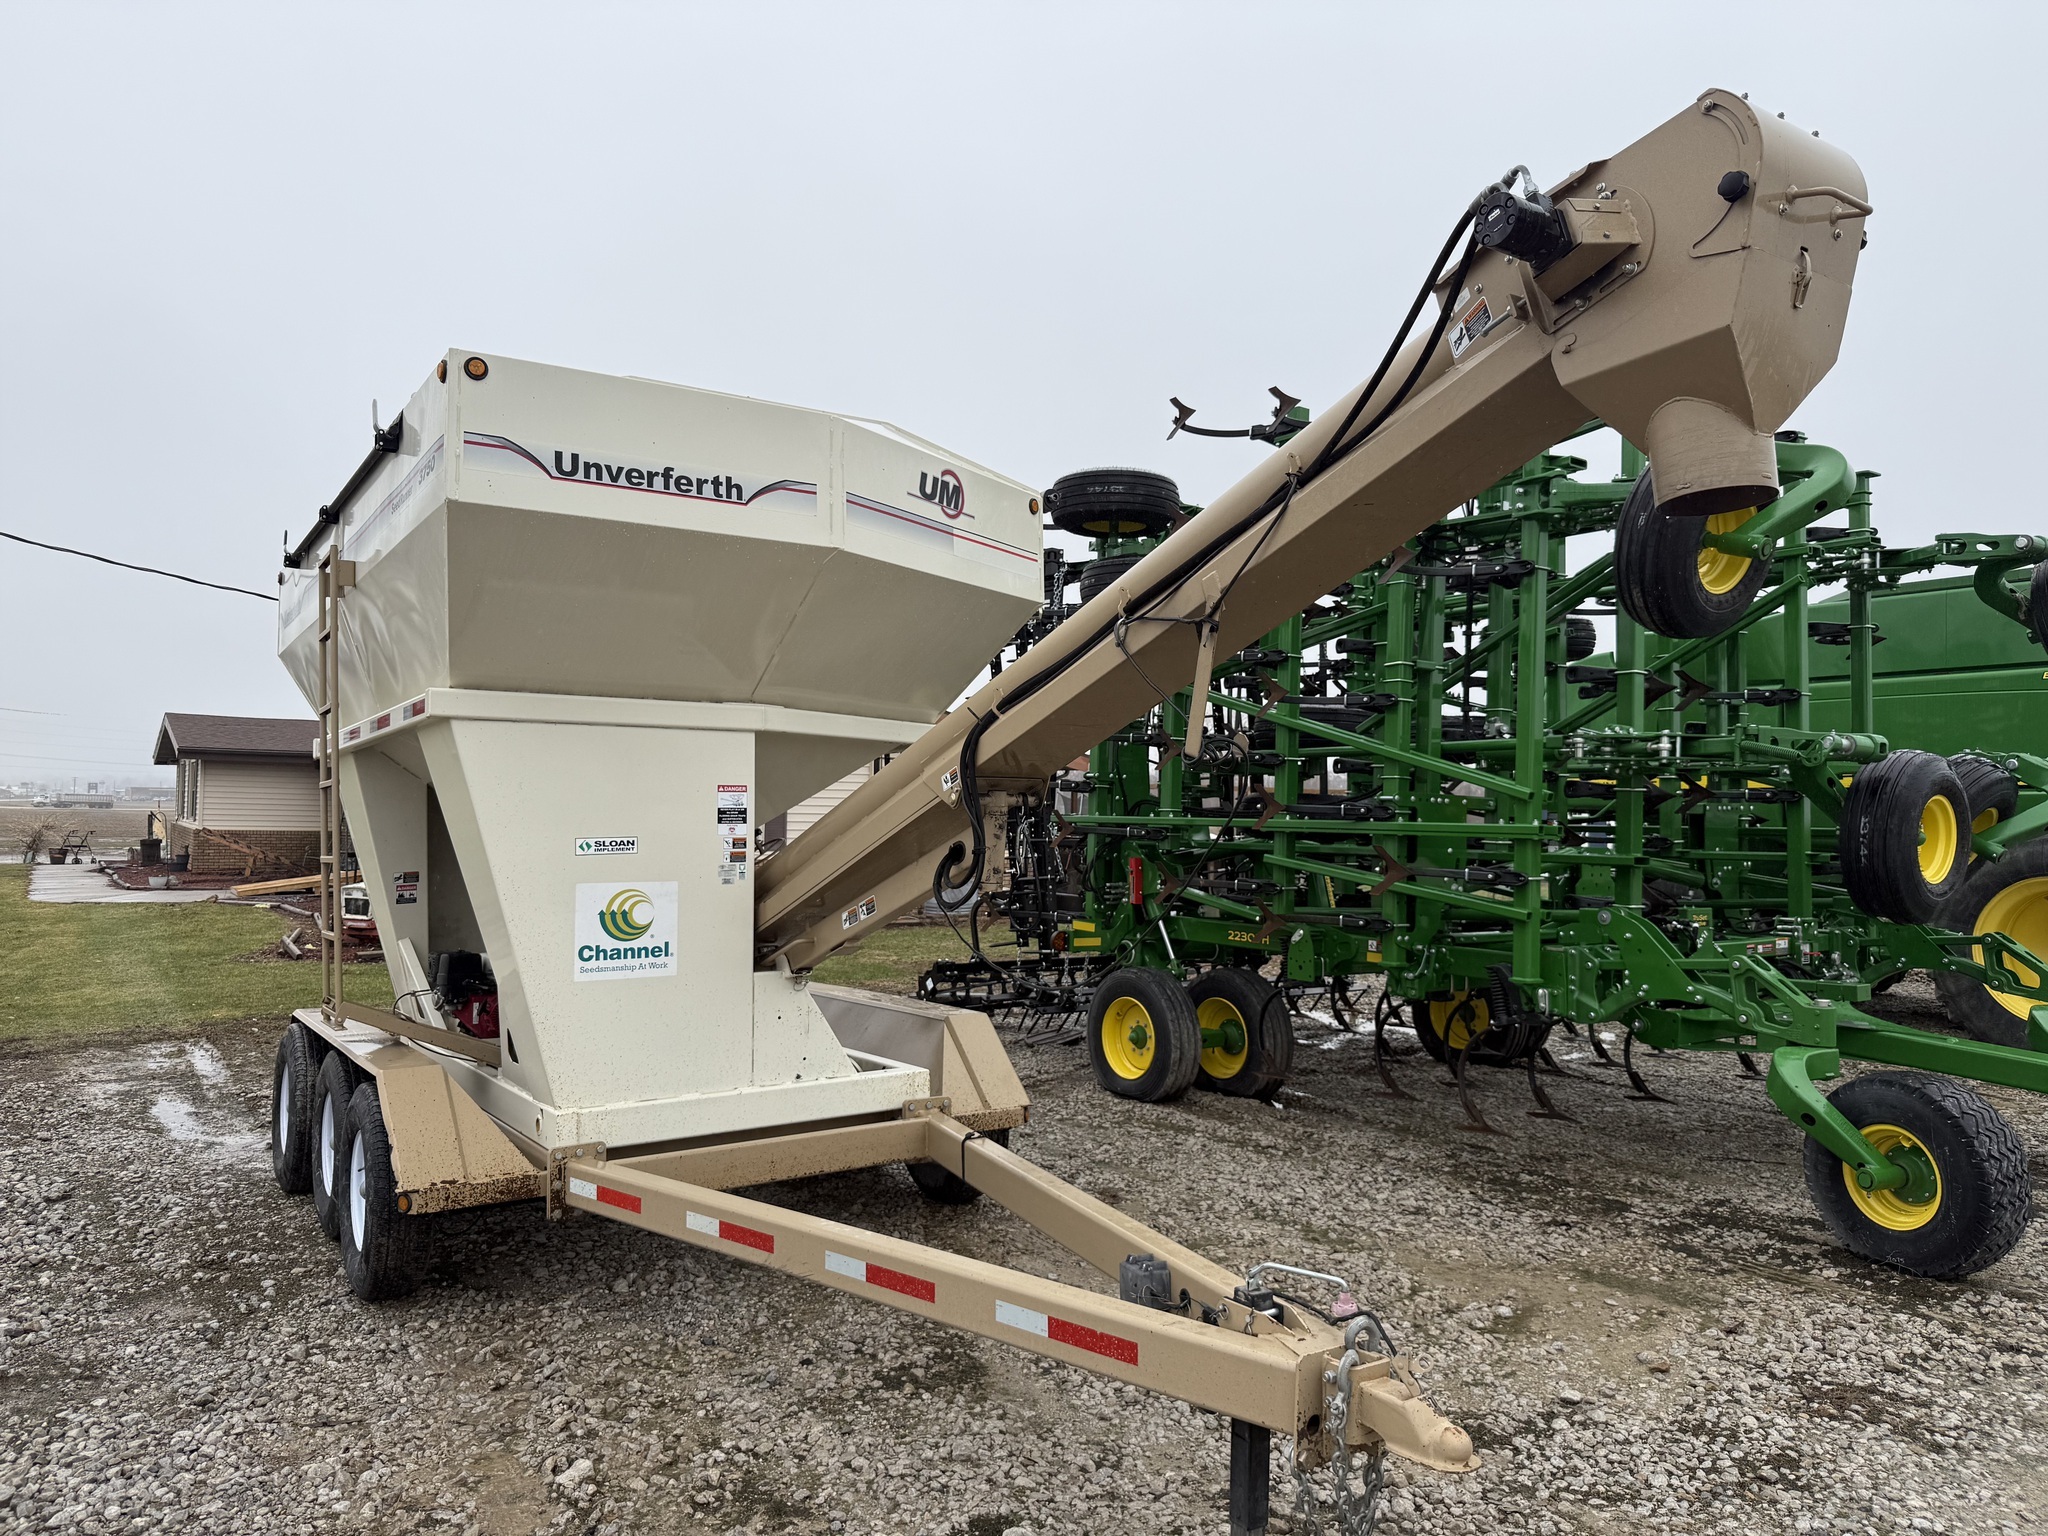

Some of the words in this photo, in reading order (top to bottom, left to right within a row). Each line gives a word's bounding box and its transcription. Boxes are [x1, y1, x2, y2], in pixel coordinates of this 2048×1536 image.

[554, 450, 743, 502] Unverferth
[919, 471, 961, 511] UM
[594, 840, 635, 848] SLOAN
[1228, 930, 1270, 945] 2230H
[579, 963, 637, 974] Seedsmanship
[638, 962, 647, 971] At
[648, 961, 669, 970] Work
